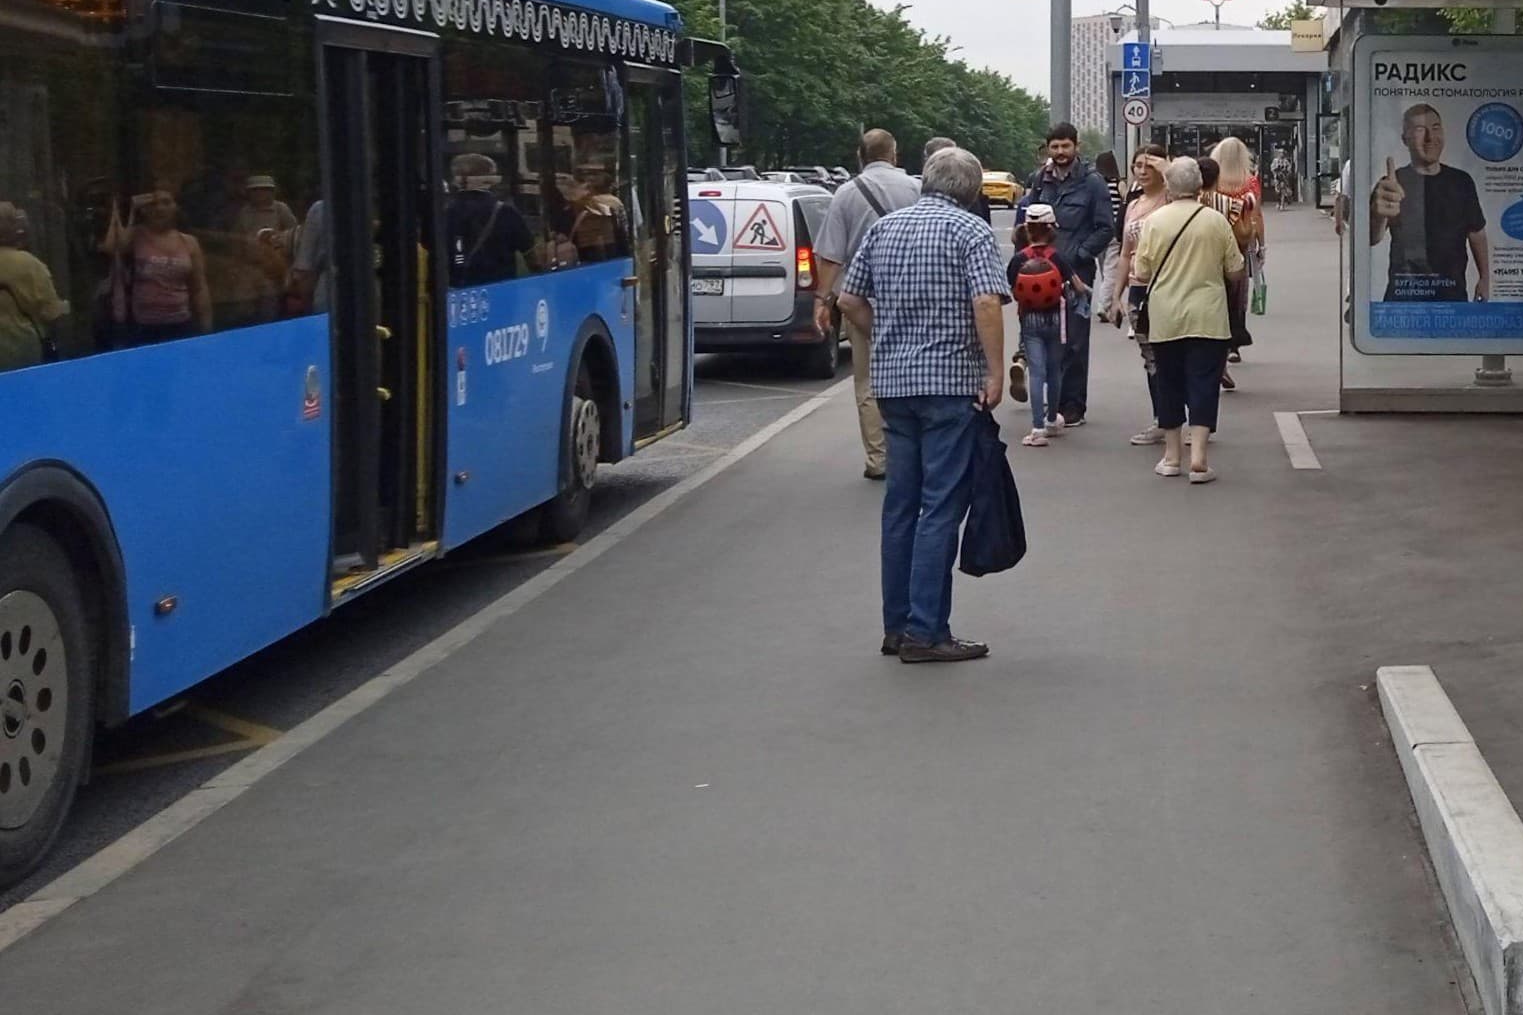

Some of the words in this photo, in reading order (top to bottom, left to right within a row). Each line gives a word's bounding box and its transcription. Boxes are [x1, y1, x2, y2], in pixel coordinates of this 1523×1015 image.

[1374, 62, 1467, 84] РАДИКС
[1373, 87, 1430, 98] ПОНЯТНАЯ
[1432, 87, 1516, 99] СТОМАТОЛОГИЯ
[1127, 104, 1145, 118] 40
[1480, 120, 1514, 141] 1000
[485, 322, 529, 366] 081729
